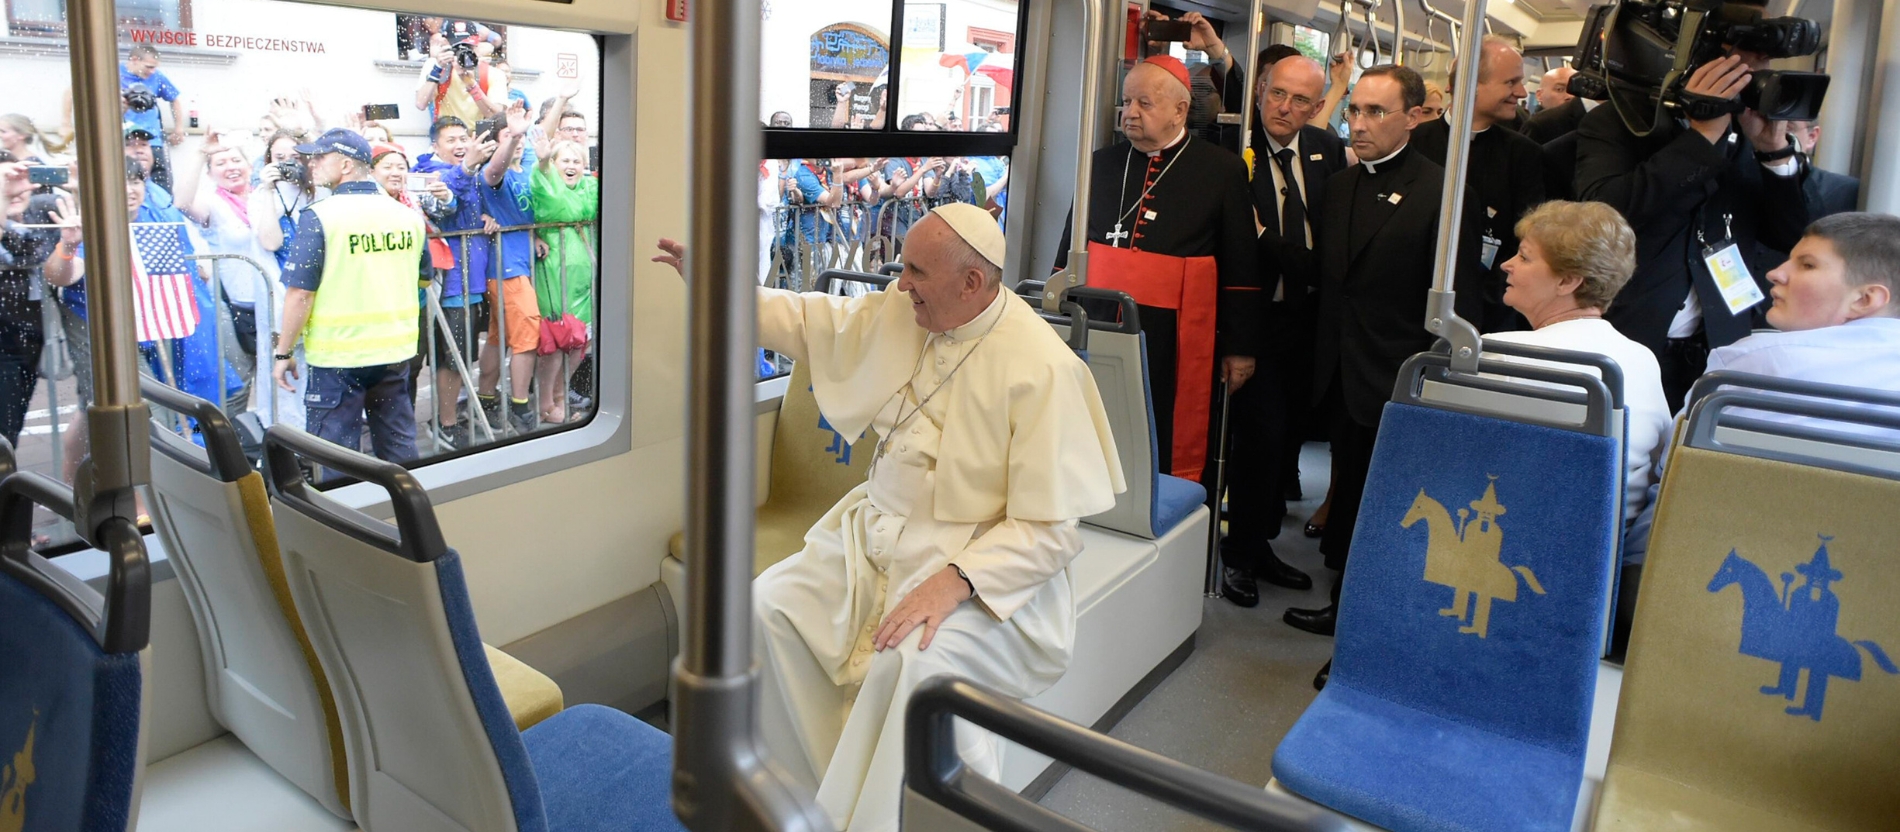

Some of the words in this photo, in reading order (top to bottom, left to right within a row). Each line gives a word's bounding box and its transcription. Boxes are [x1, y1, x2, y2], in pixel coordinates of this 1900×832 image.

[130, 28, 197, 46] WYJŚCIE
[206, 34, 326, 54] BEZPIECZEŃSTWA
[348, 230, 413, 254] POLICJA
